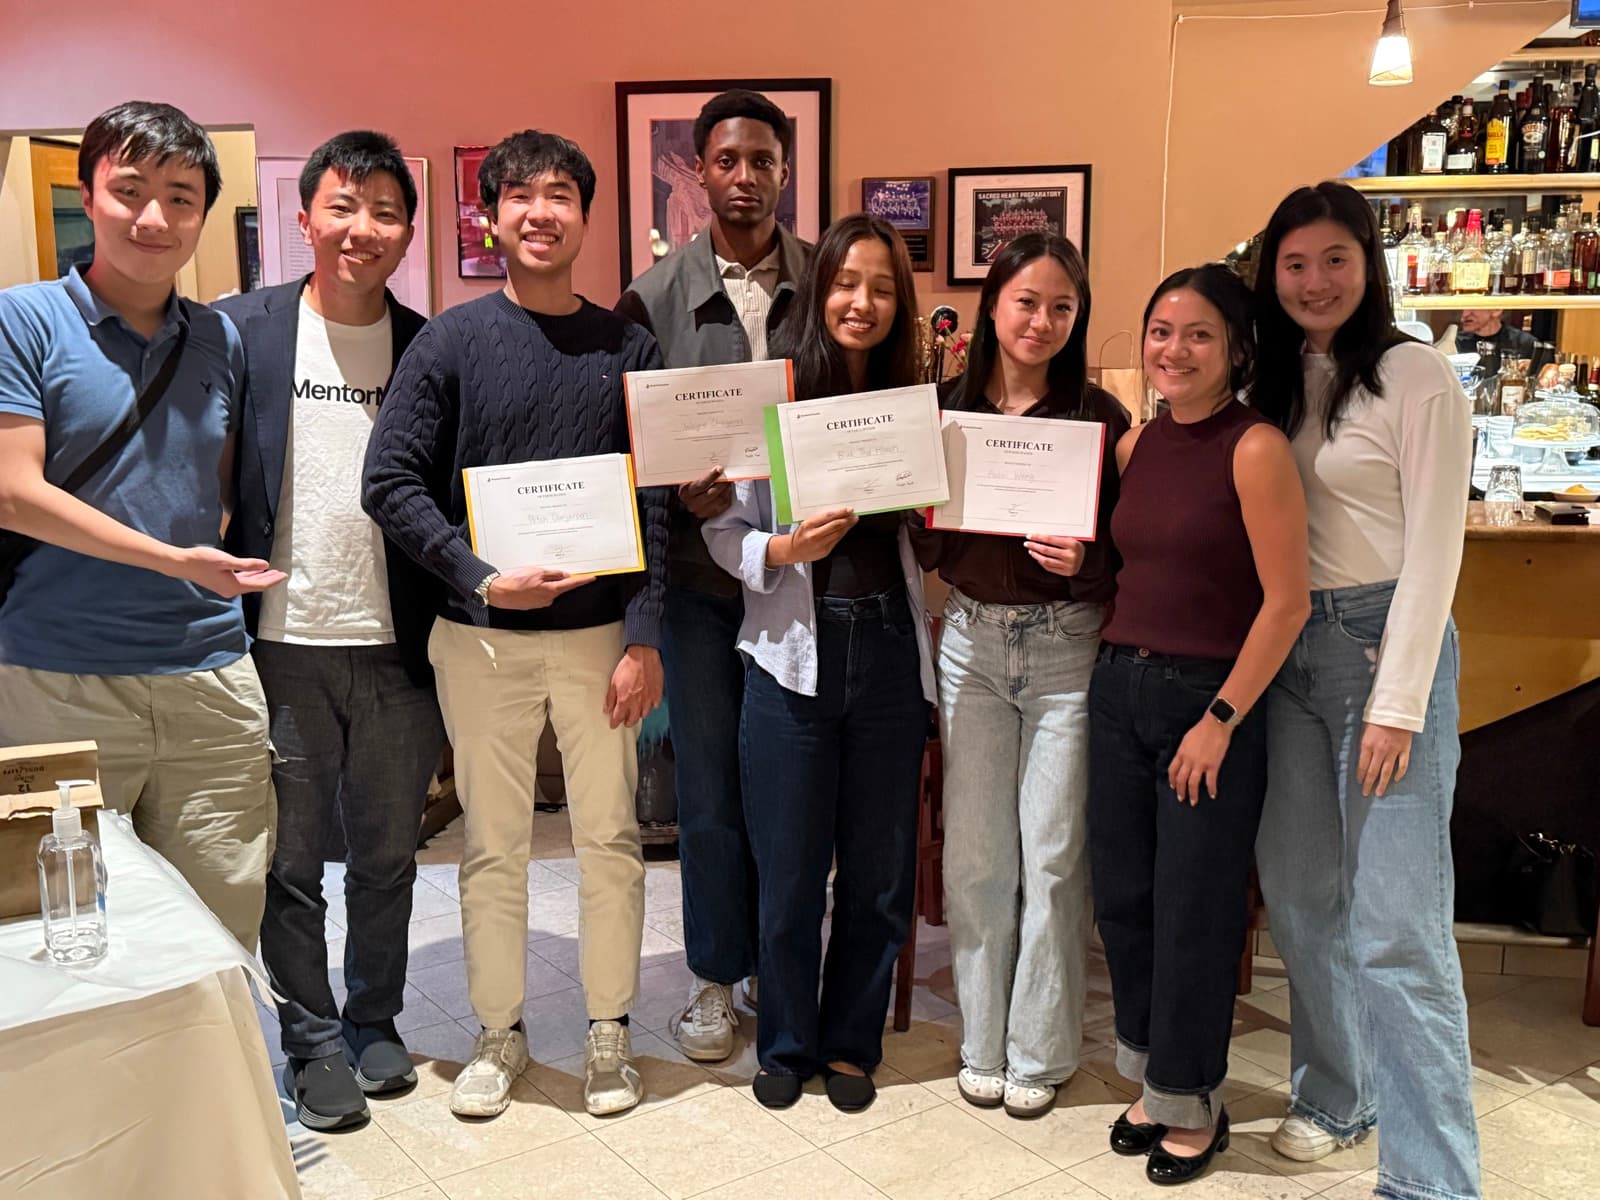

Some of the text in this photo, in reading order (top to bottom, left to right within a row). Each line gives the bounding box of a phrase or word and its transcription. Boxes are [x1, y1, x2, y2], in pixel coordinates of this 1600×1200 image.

[978, 192, 1000, 200] SACRED
[1000, 191, 1019, 199] HEART
[674, 388, 743, 402] CERTIFICATE
[826, 413, 895, 431] CERTIFICATE
[985, 438, 1054, 452] CERTIFICATE
[517, 481, 585, 495] CERTIFICATE
